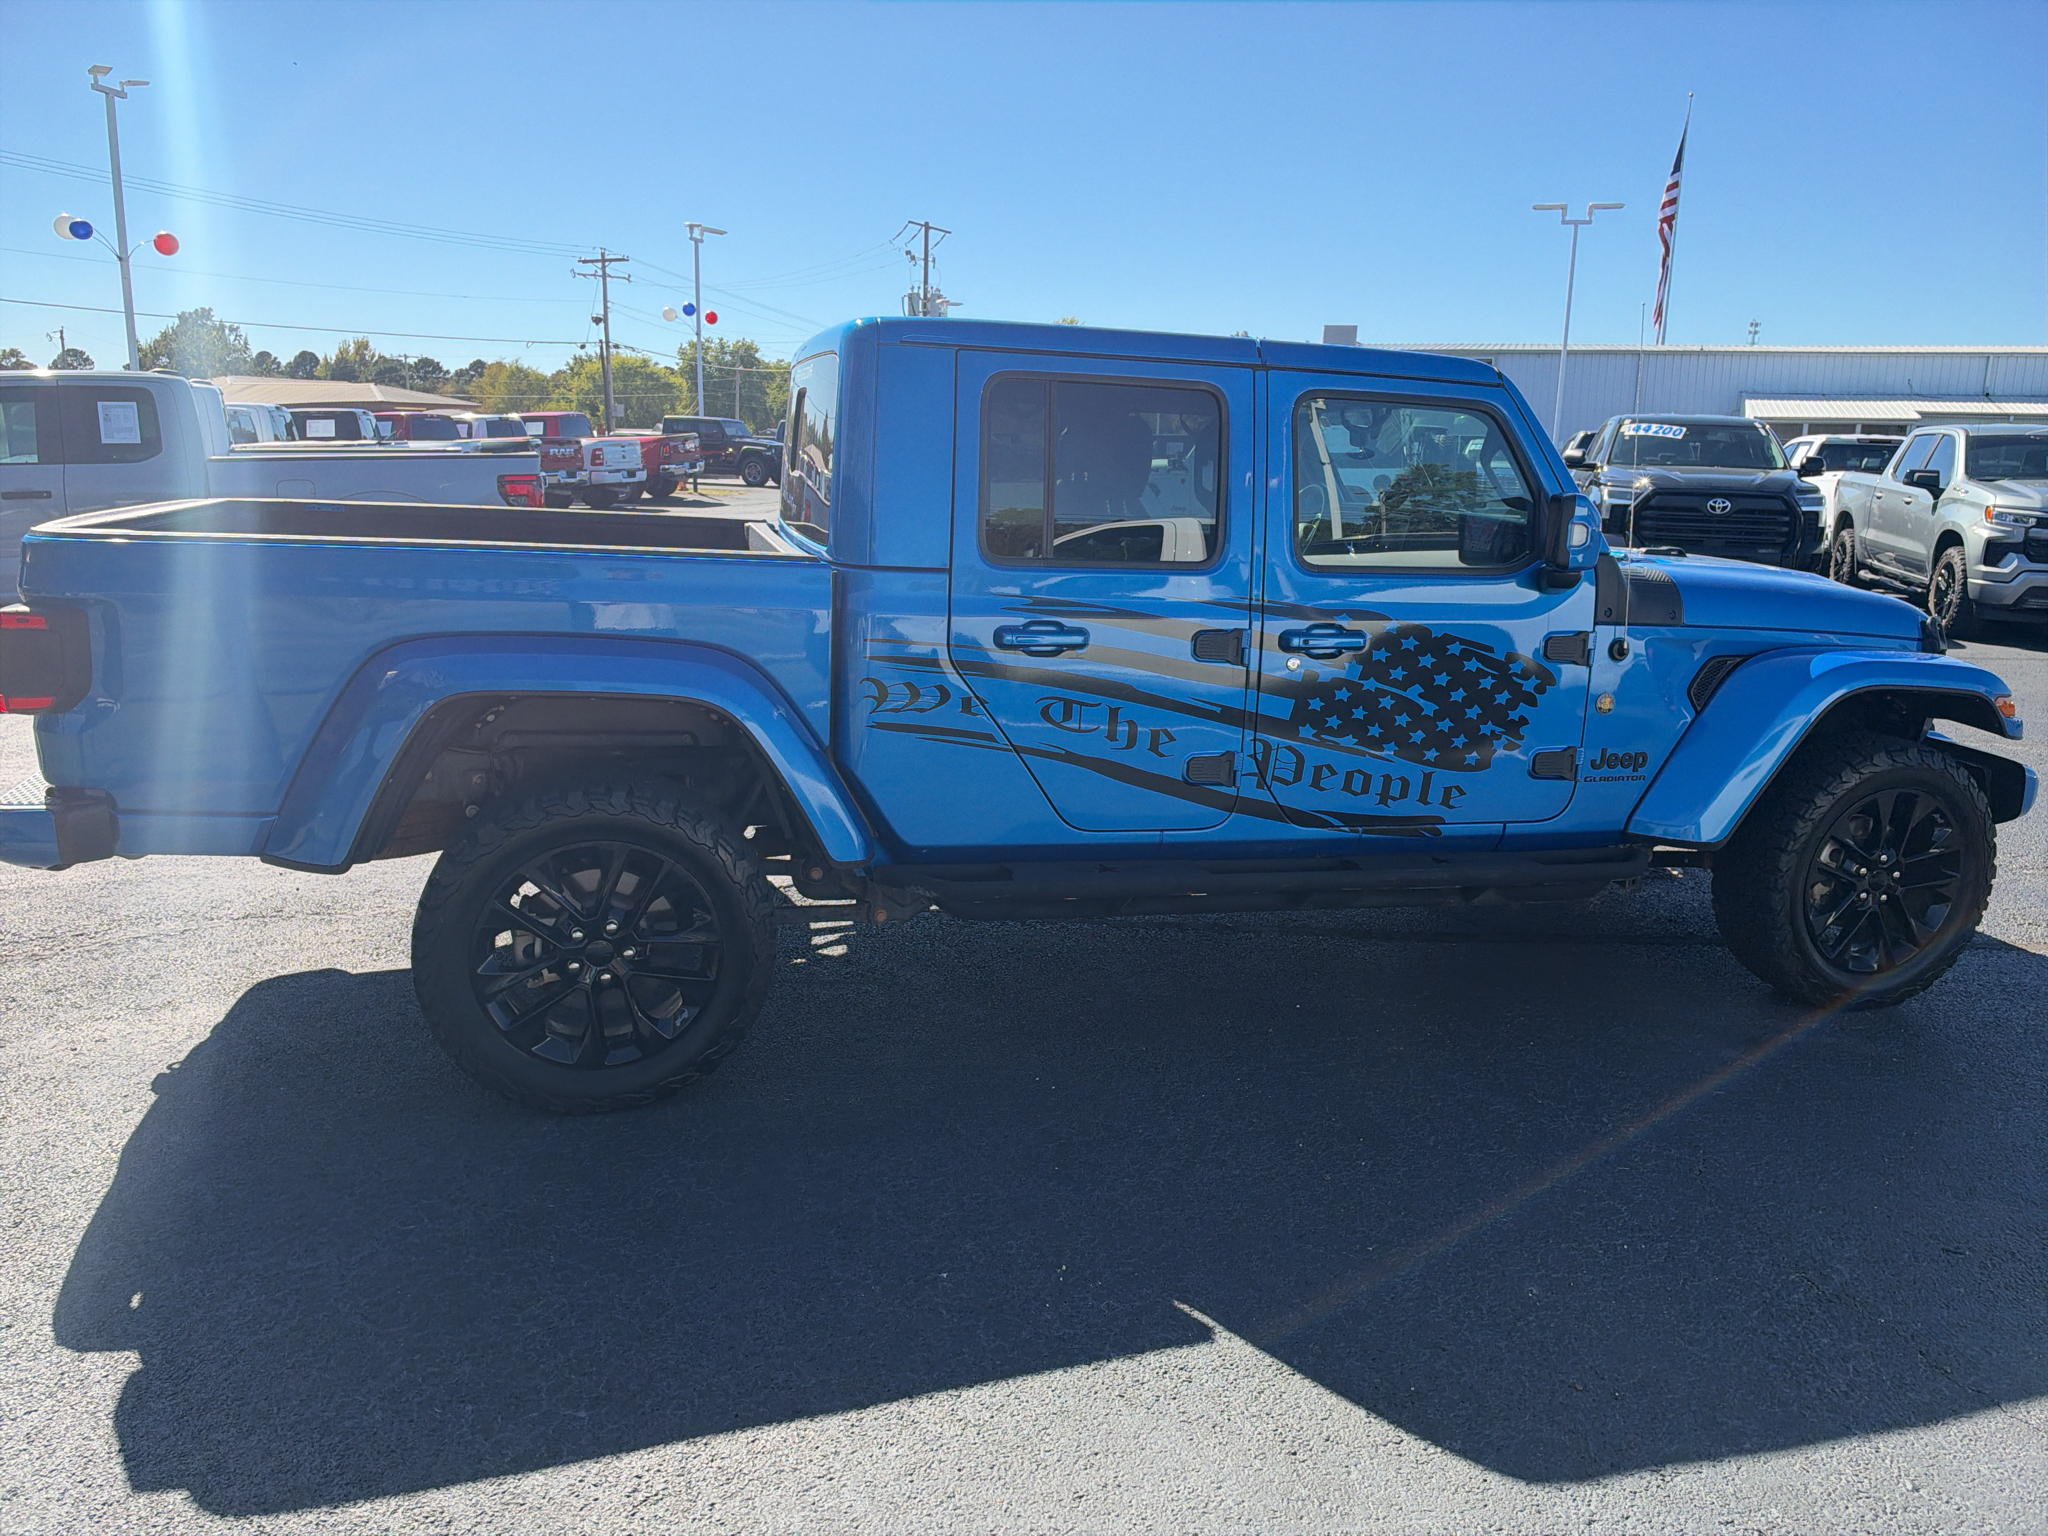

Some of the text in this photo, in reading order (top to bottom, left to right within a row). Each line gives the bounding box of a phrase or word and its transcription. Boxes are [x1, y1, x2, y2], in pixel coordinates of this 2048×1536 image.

[1626, 424, 1683, 437] $44200
[859, 677, 1467, 810] We The People
[1590, 748, 1649, 773] Jeep
[1583, 774, 1646, 783] GLADIATOR
